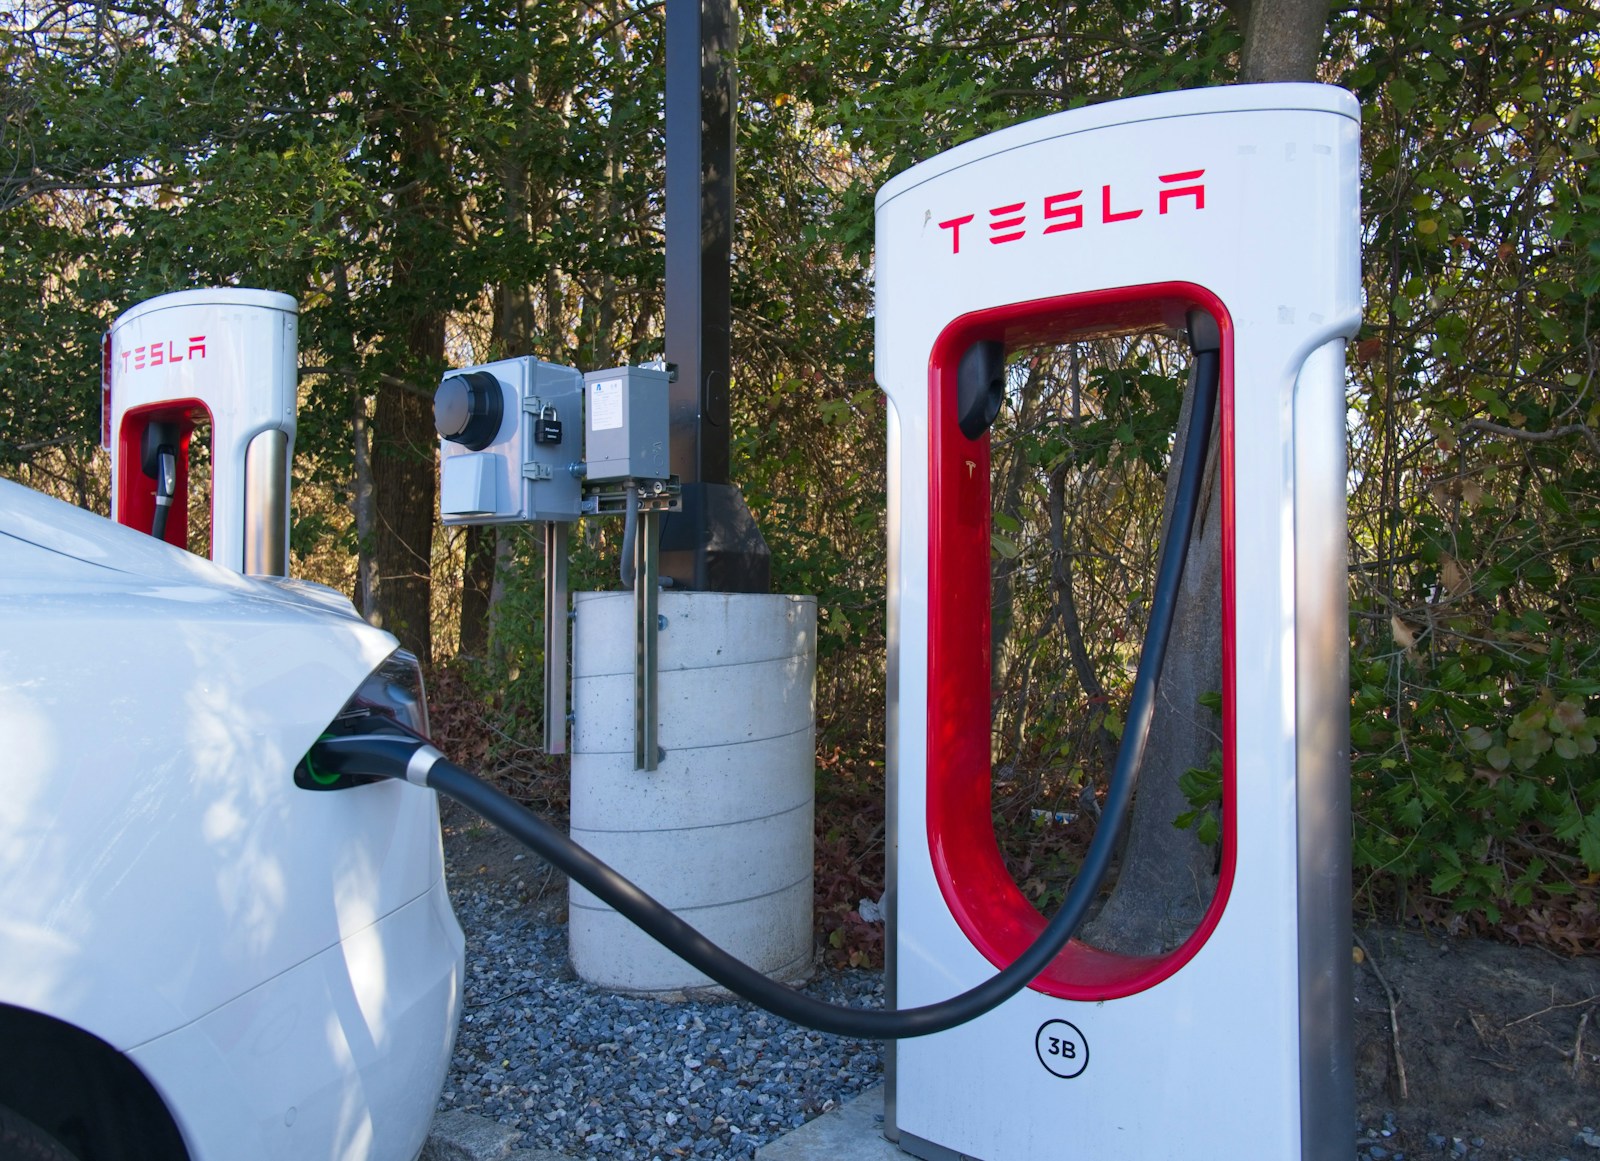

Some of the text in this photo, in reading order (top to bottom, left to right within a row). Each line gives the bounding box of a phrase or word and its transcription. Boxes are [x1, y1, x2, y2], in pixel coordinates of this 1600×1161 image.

[938, 169, 1205, 254] TESLA
[121, 336, 206, 373] TESLA
[1048, 1036, 1076, 1059] 3B
